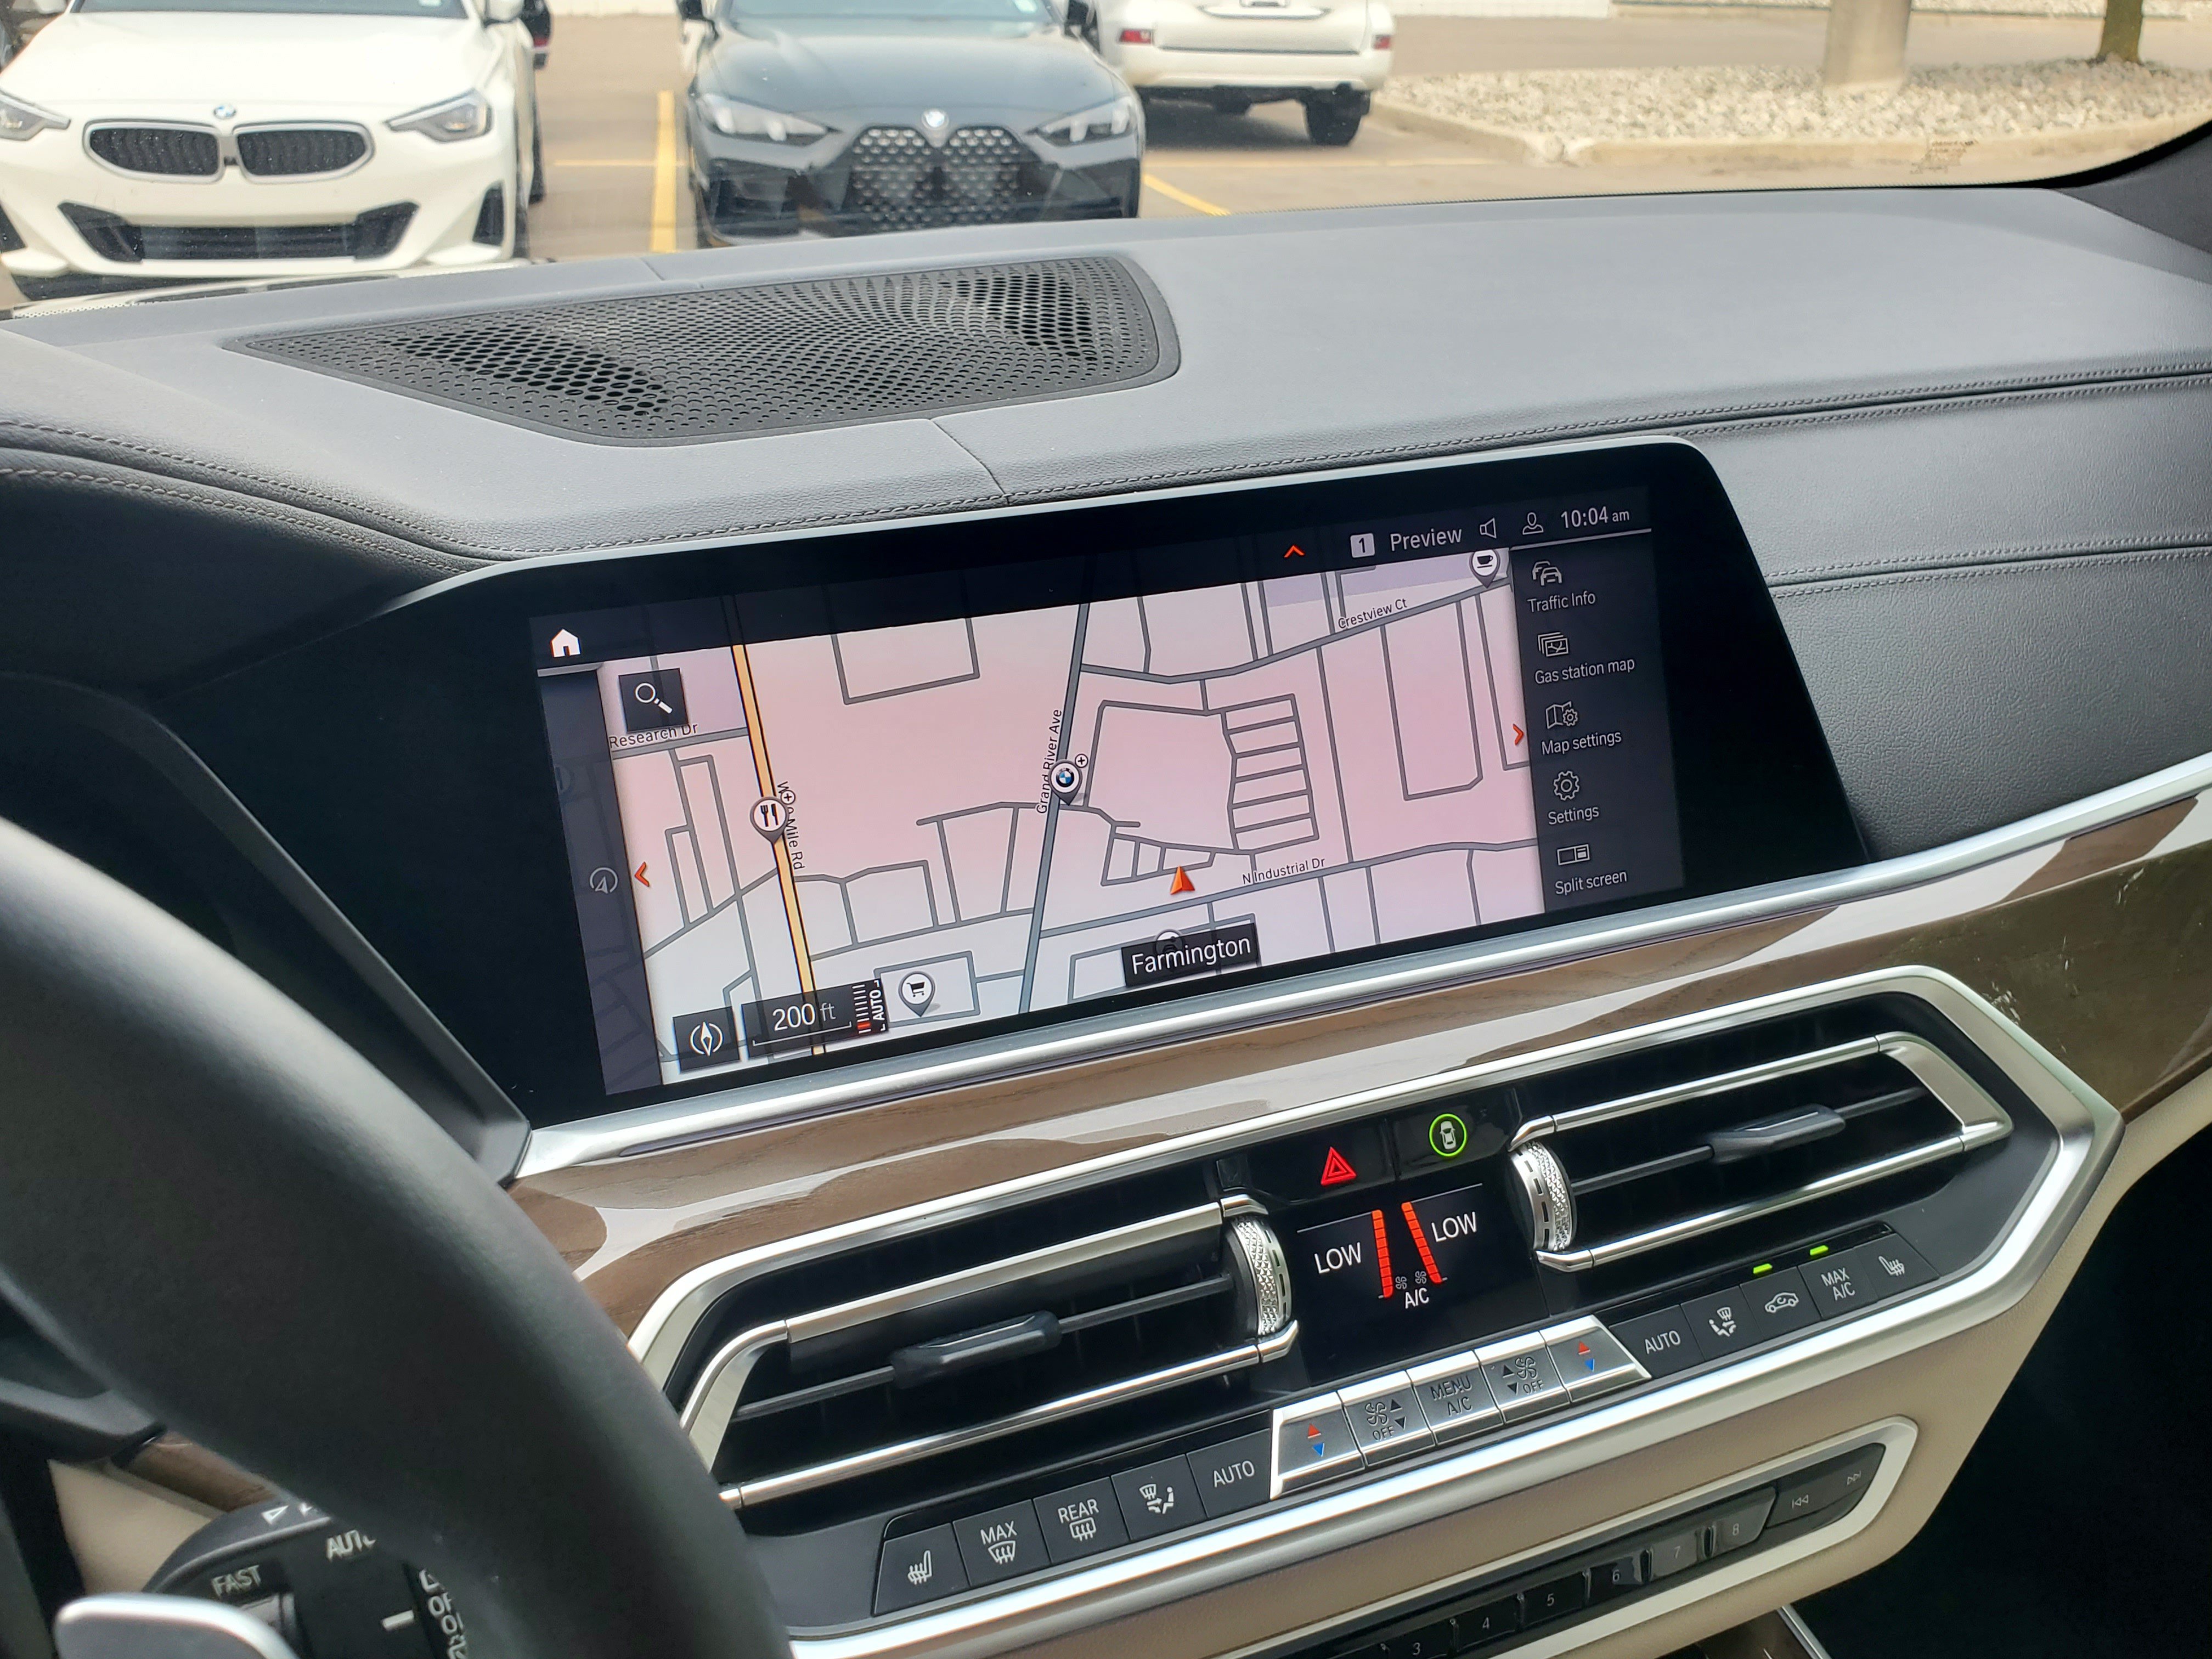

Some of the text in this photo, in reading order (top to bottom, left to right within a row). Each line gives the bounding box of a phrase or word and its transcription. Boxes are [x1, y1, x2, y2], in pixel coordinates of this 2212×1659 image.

[1561, 506, 1629, 528] 10:04 am
[1390, 527, 1462, 551] Preview
[1338, 599, 1407, 629] Crestview Ct
[1527, 591, 1595, 613] Traffic Info
[1535, 659, 1635, 685] Gas station map
[609, 724, 698, 748] Research Dr
[1542, 730, 1621, 758] Map settings
[1036, 709, 1062, 814] Grand River Ave
[1548, 805, 1599, 827] Settings
[786, 819, 799, 848] Mile
[791, 851, 805, 870] Rd
[1242, 858, 1325, 884] N Industrial Dr
[1555, 870, 1627, 896] Split screen
[1131, 936, 1250, 975] Farmington
[773, 1002, 836, 1031] 200 ft
[870, 990, 884, 1020] AUTO
[1431, 1212, 1478, 1243] LOW
[1314, 1242, 1362, 1274] LOW
[1821, 1267, 1850, 1287] MAX
[1404, 1288, 1430, 1309] A/C
[1832, 1282, 1856, 1301] A/C
[1644, 1330, 1681, 1355] AUTO
[1430, 1376, 1473, 1401] MENU
[1522, 1379, 1544, 1395] OFF
[1447, 1397, 1473, 1417] A/C
[1373, 1426, 1395, 1441] OFF
[1213, 1460, 1255, 1488] AUTO
[1058, 1498, 1099, 1523] REAR
[980, 1521, 1018, 1544] MAX
[1733, 1523, 1739, 1536] 8
[1674, 1546, 1680, 1559] 7
[211, 1565, 261, 1596] FAST
[1612, 1570, 1620, 1582] 6
[1547, 1593, 1554, 1606] 5
[1482, 1617, 1489, 1629] 4
[1413, 1643, 1420, 1655] 3
